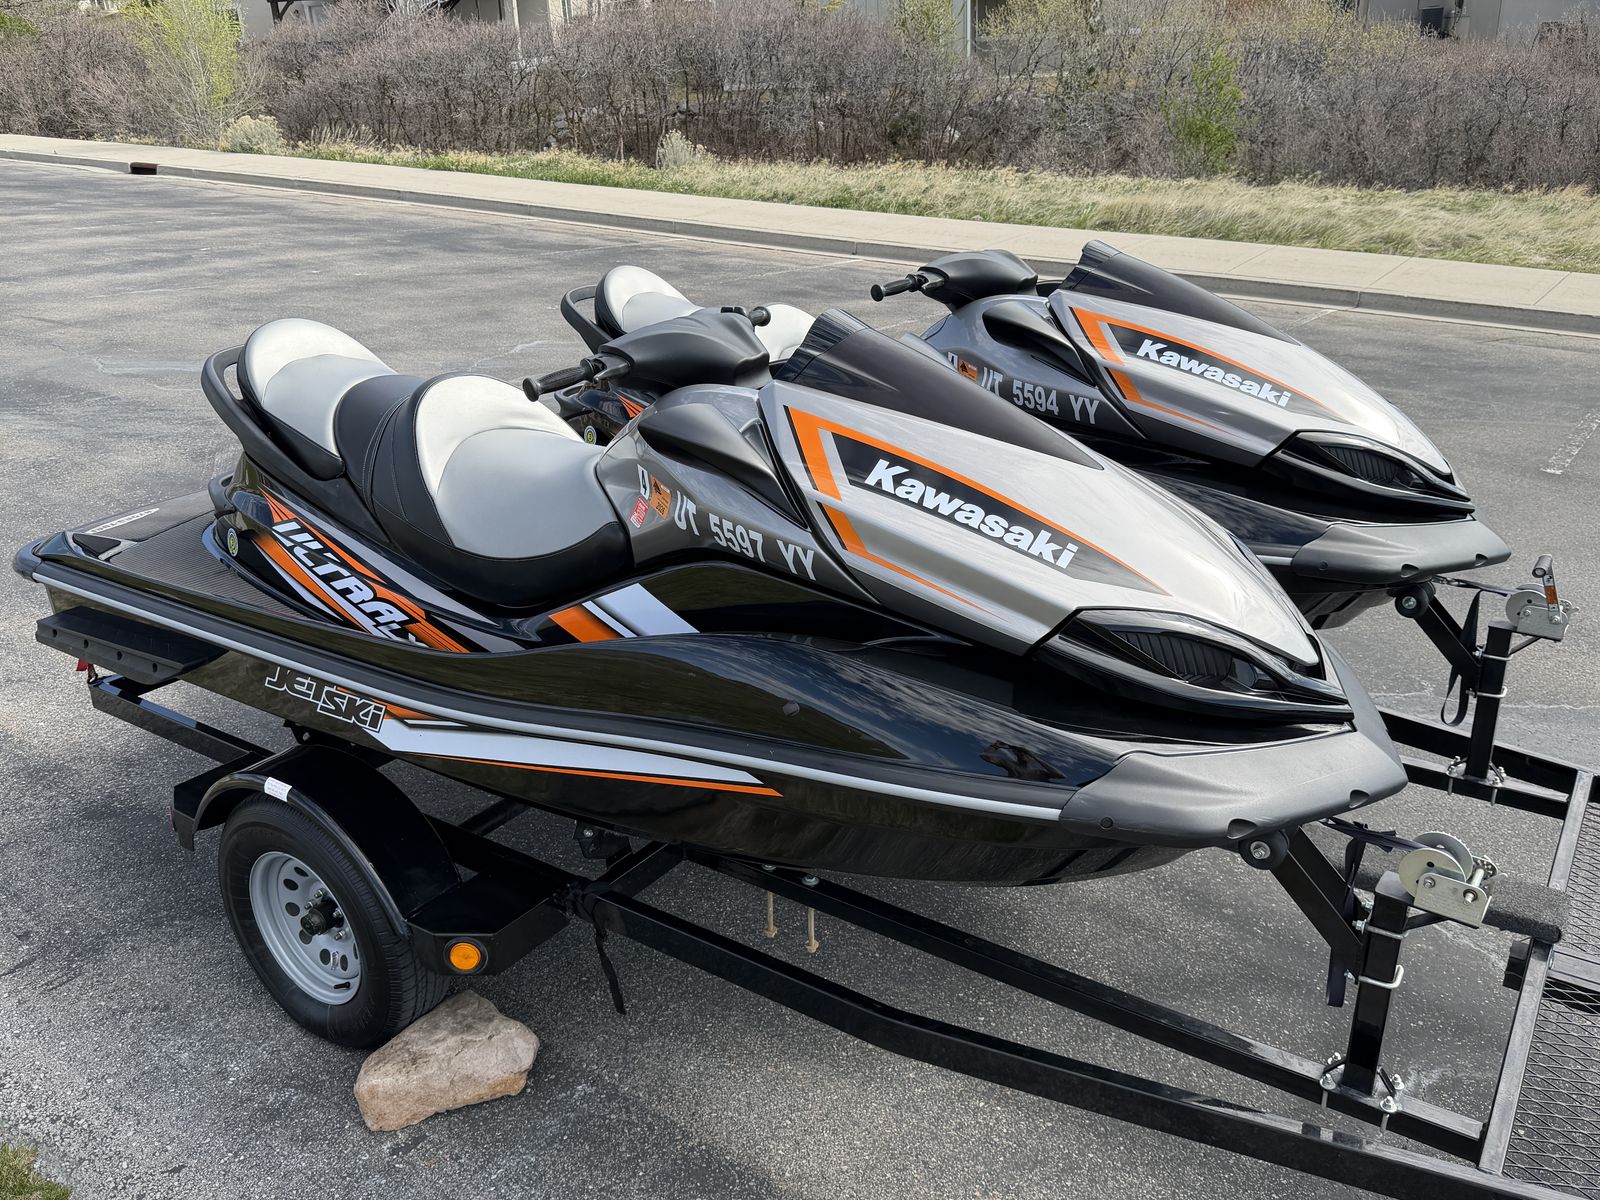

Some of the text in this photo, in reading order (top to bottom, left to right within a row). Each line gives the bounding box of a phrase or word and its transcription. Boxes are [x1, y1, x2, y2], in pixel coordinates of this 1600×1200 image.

[980, 366, 1004, 397] UT
[1012, 379, 1060, 416] 5594
[1069, 394, 1100, 425] YY
[1136, 338, 1292, 408] Kawasaki
[674, 490, 700, 536] UT
[708, 512, 767, 564] 5597
[776, 539, 817, 581] YY
[864, 458, 1079, 569] Kawasaki
[272, 520, 410, 624] ULTRA
